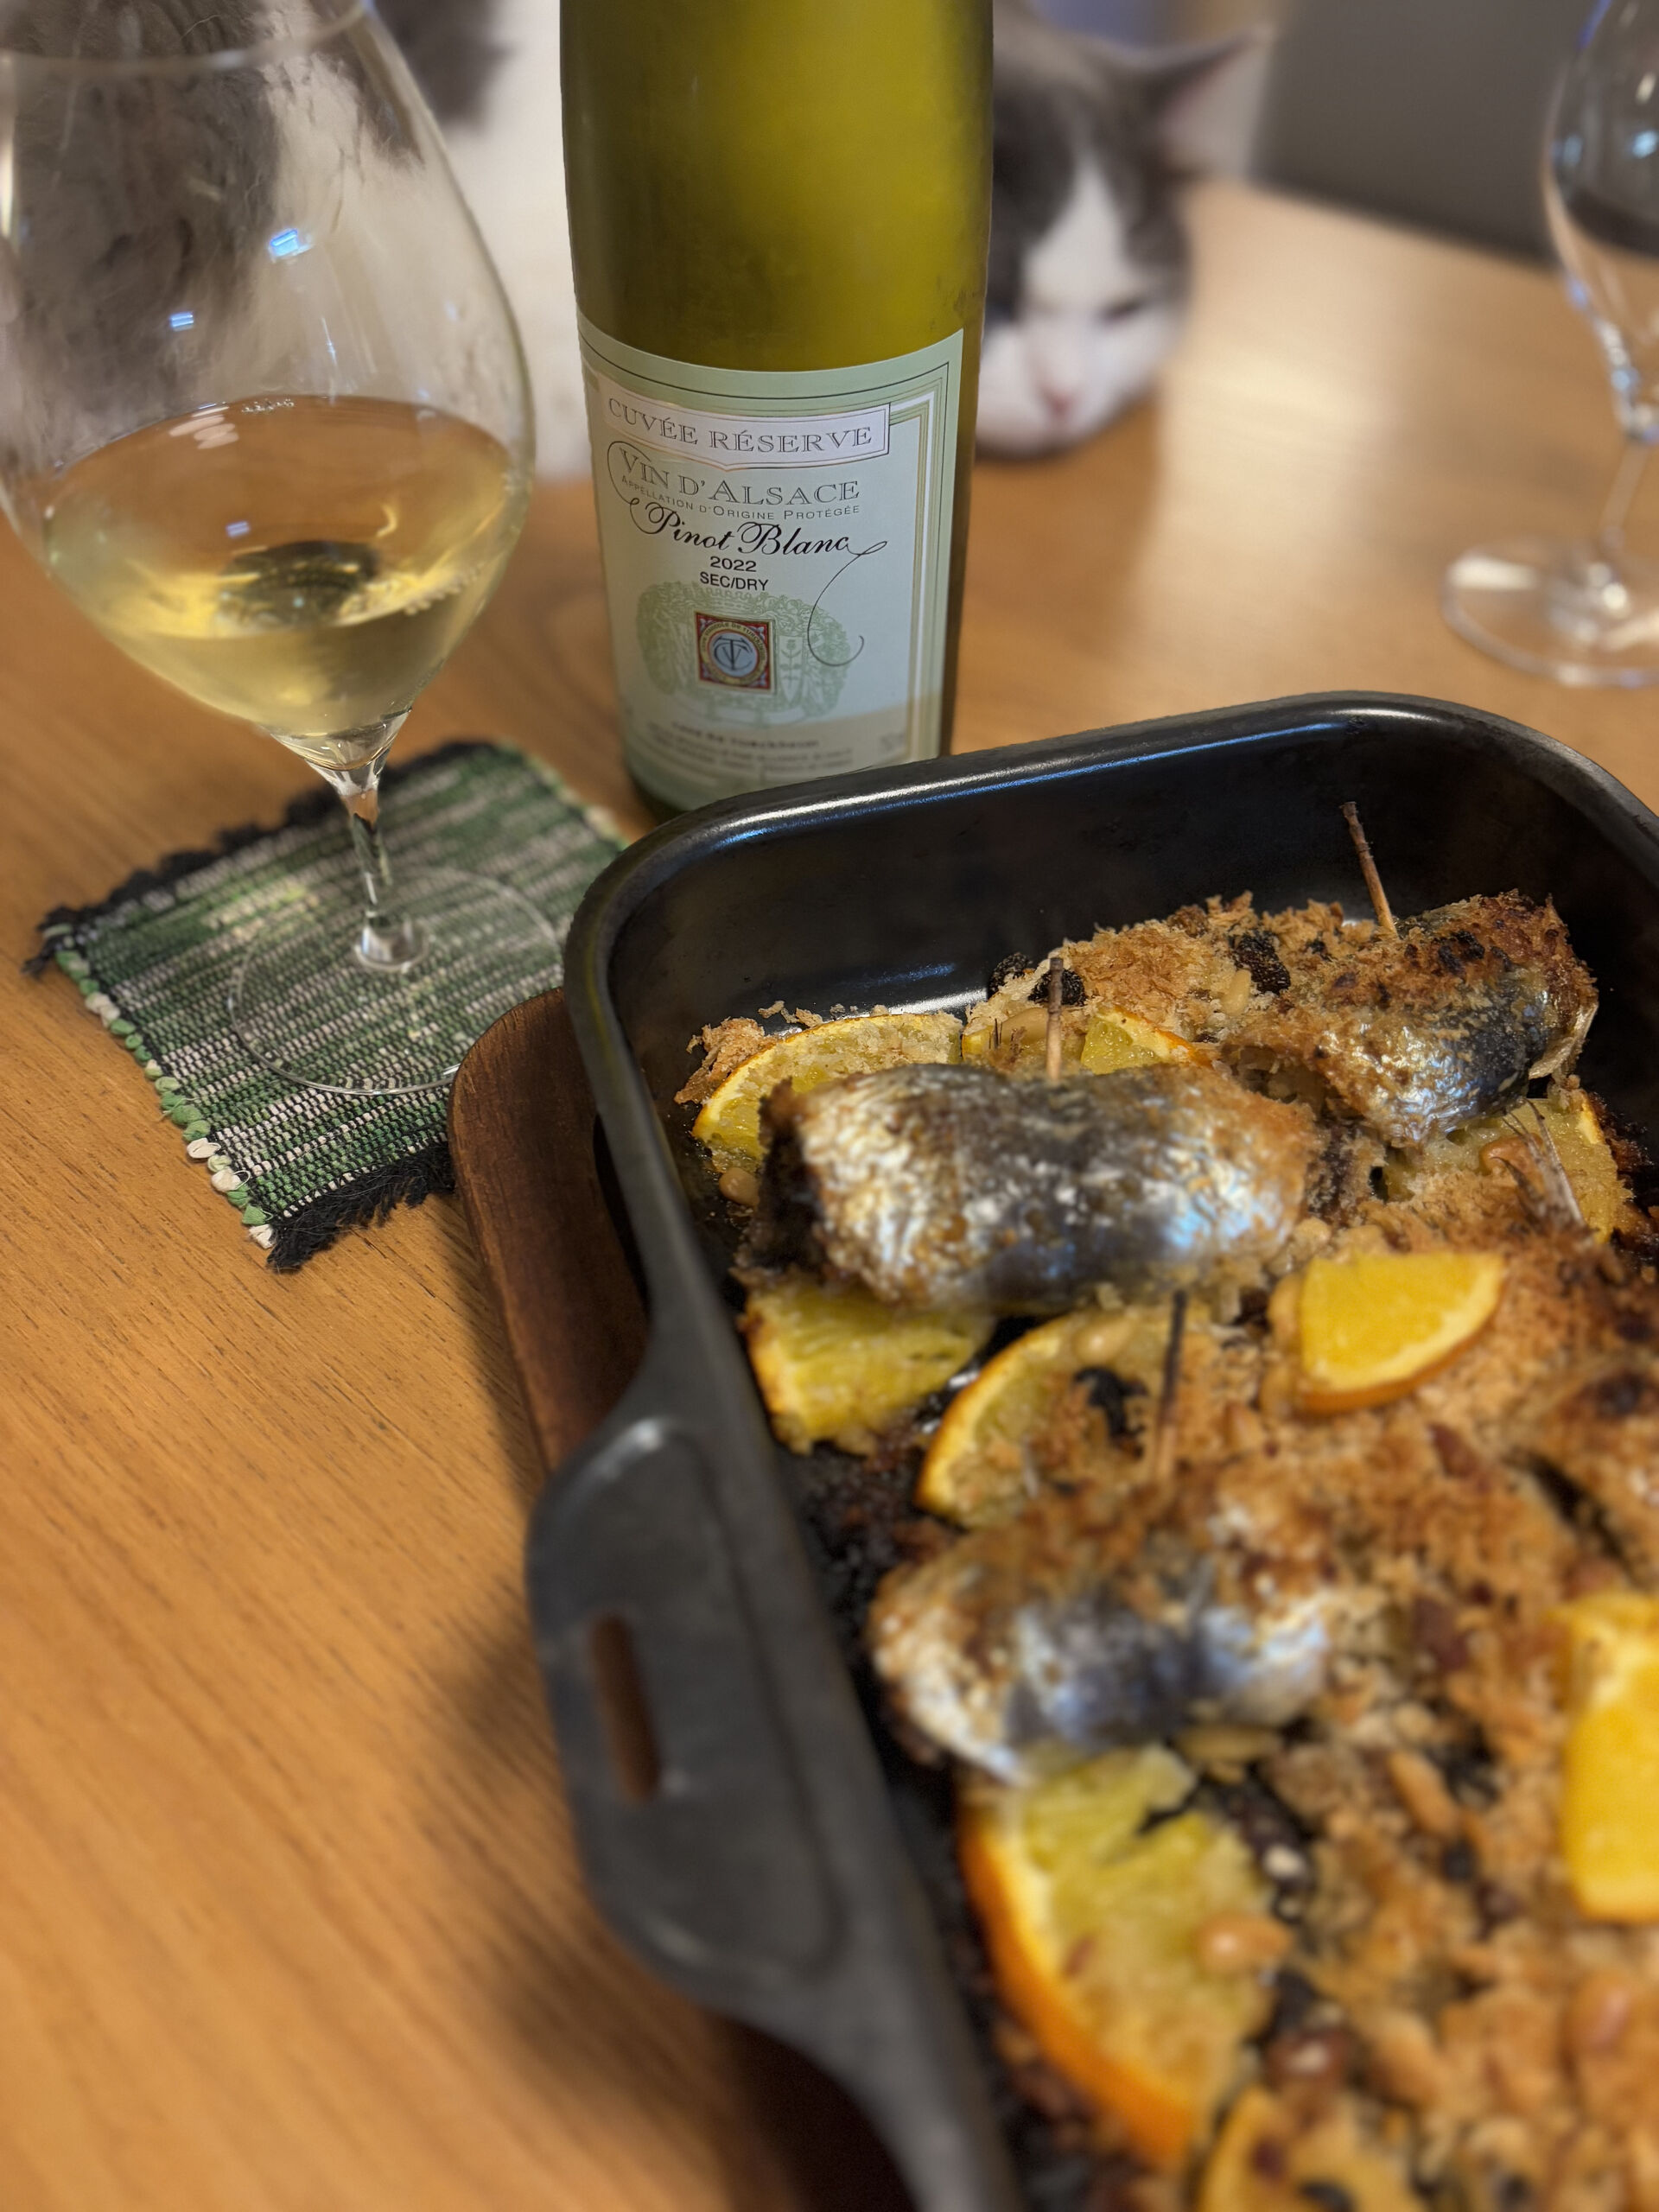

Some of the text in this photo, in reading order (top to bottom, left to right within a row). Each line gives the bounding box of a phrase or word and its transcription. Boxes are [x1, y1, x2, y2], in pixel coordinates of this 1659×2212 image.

[608, 397, 873, 454] CUVÉE RÉSERVE
[619, 447, 671, 490] VIN
[621, 475, 694, 511] APPELLATION
[783, 505, 861, 520] PROTÉGÉE
[638, 501, 857, 556] Pinot Blanc
[699, 571, 769, 591] SEC/DRY
[709, 556, 757, 573] 2022
